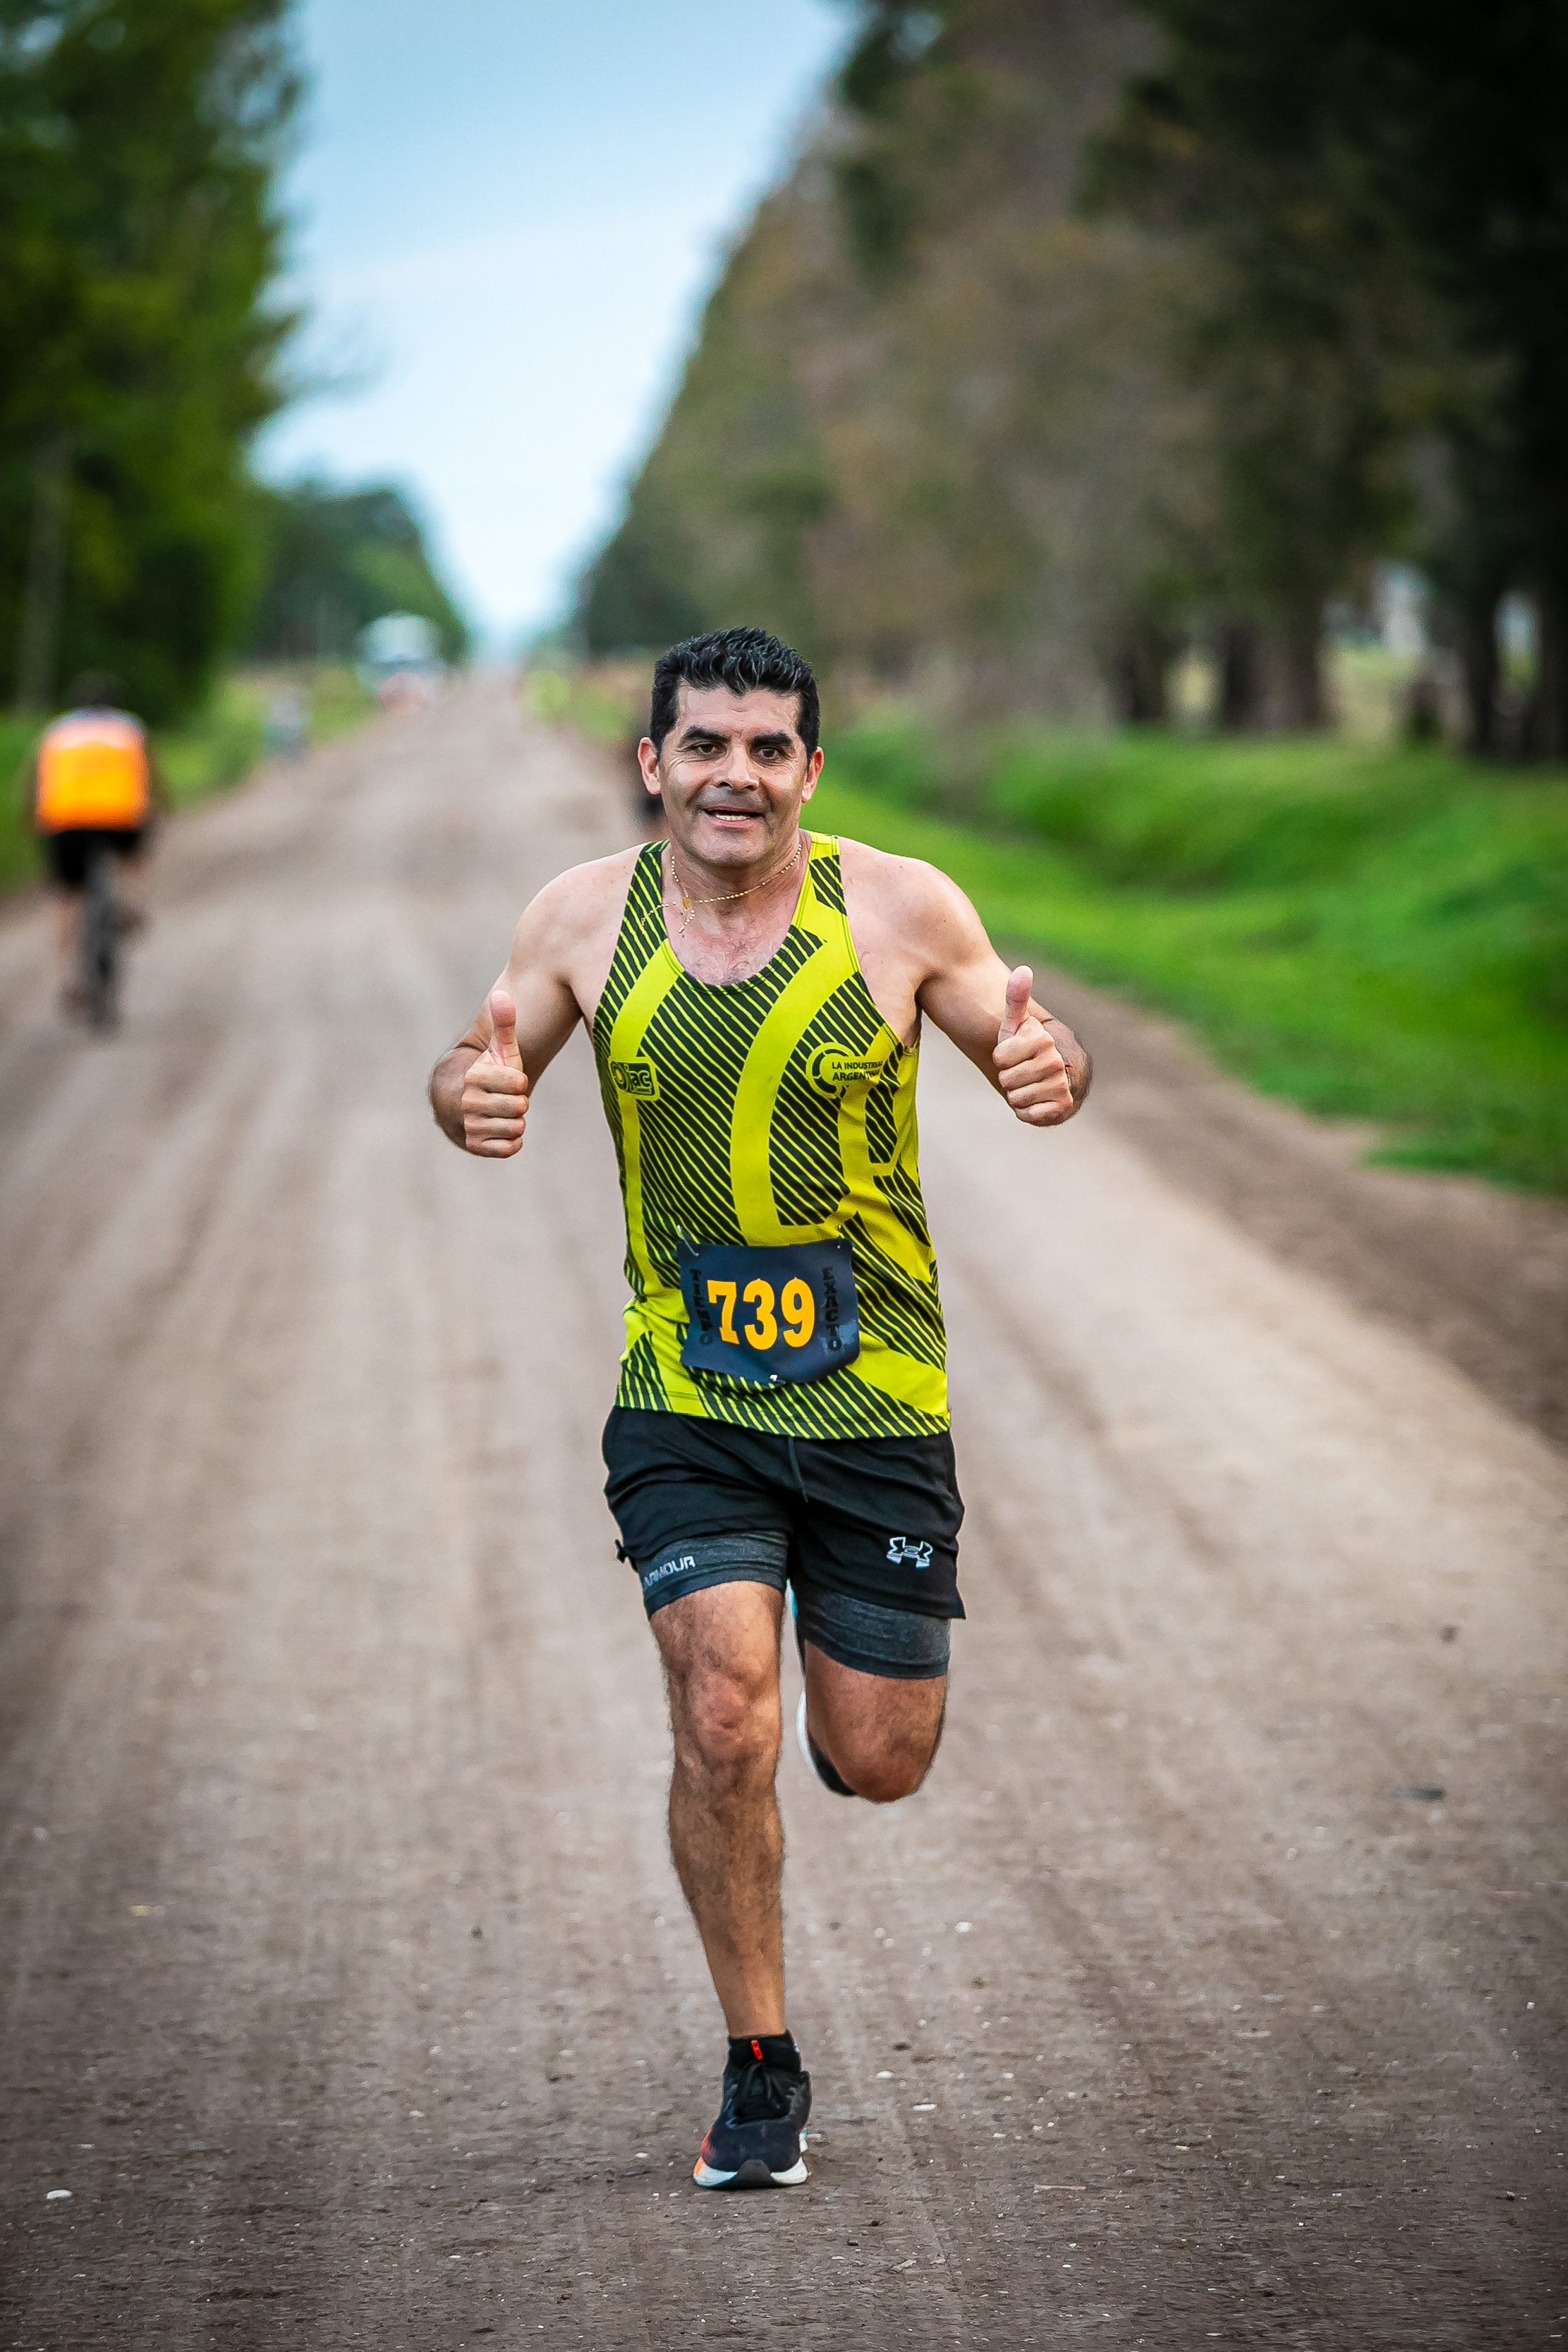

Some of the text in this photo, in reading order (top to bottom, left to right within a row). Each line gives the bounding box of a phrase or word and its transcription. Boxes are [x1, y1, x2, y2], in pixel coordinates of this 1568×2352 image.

[832, 1061, 842, 1069] LA
[832, 1069, 880, 1081] ARGEN
[707, 1277, 815, 1350] 739
